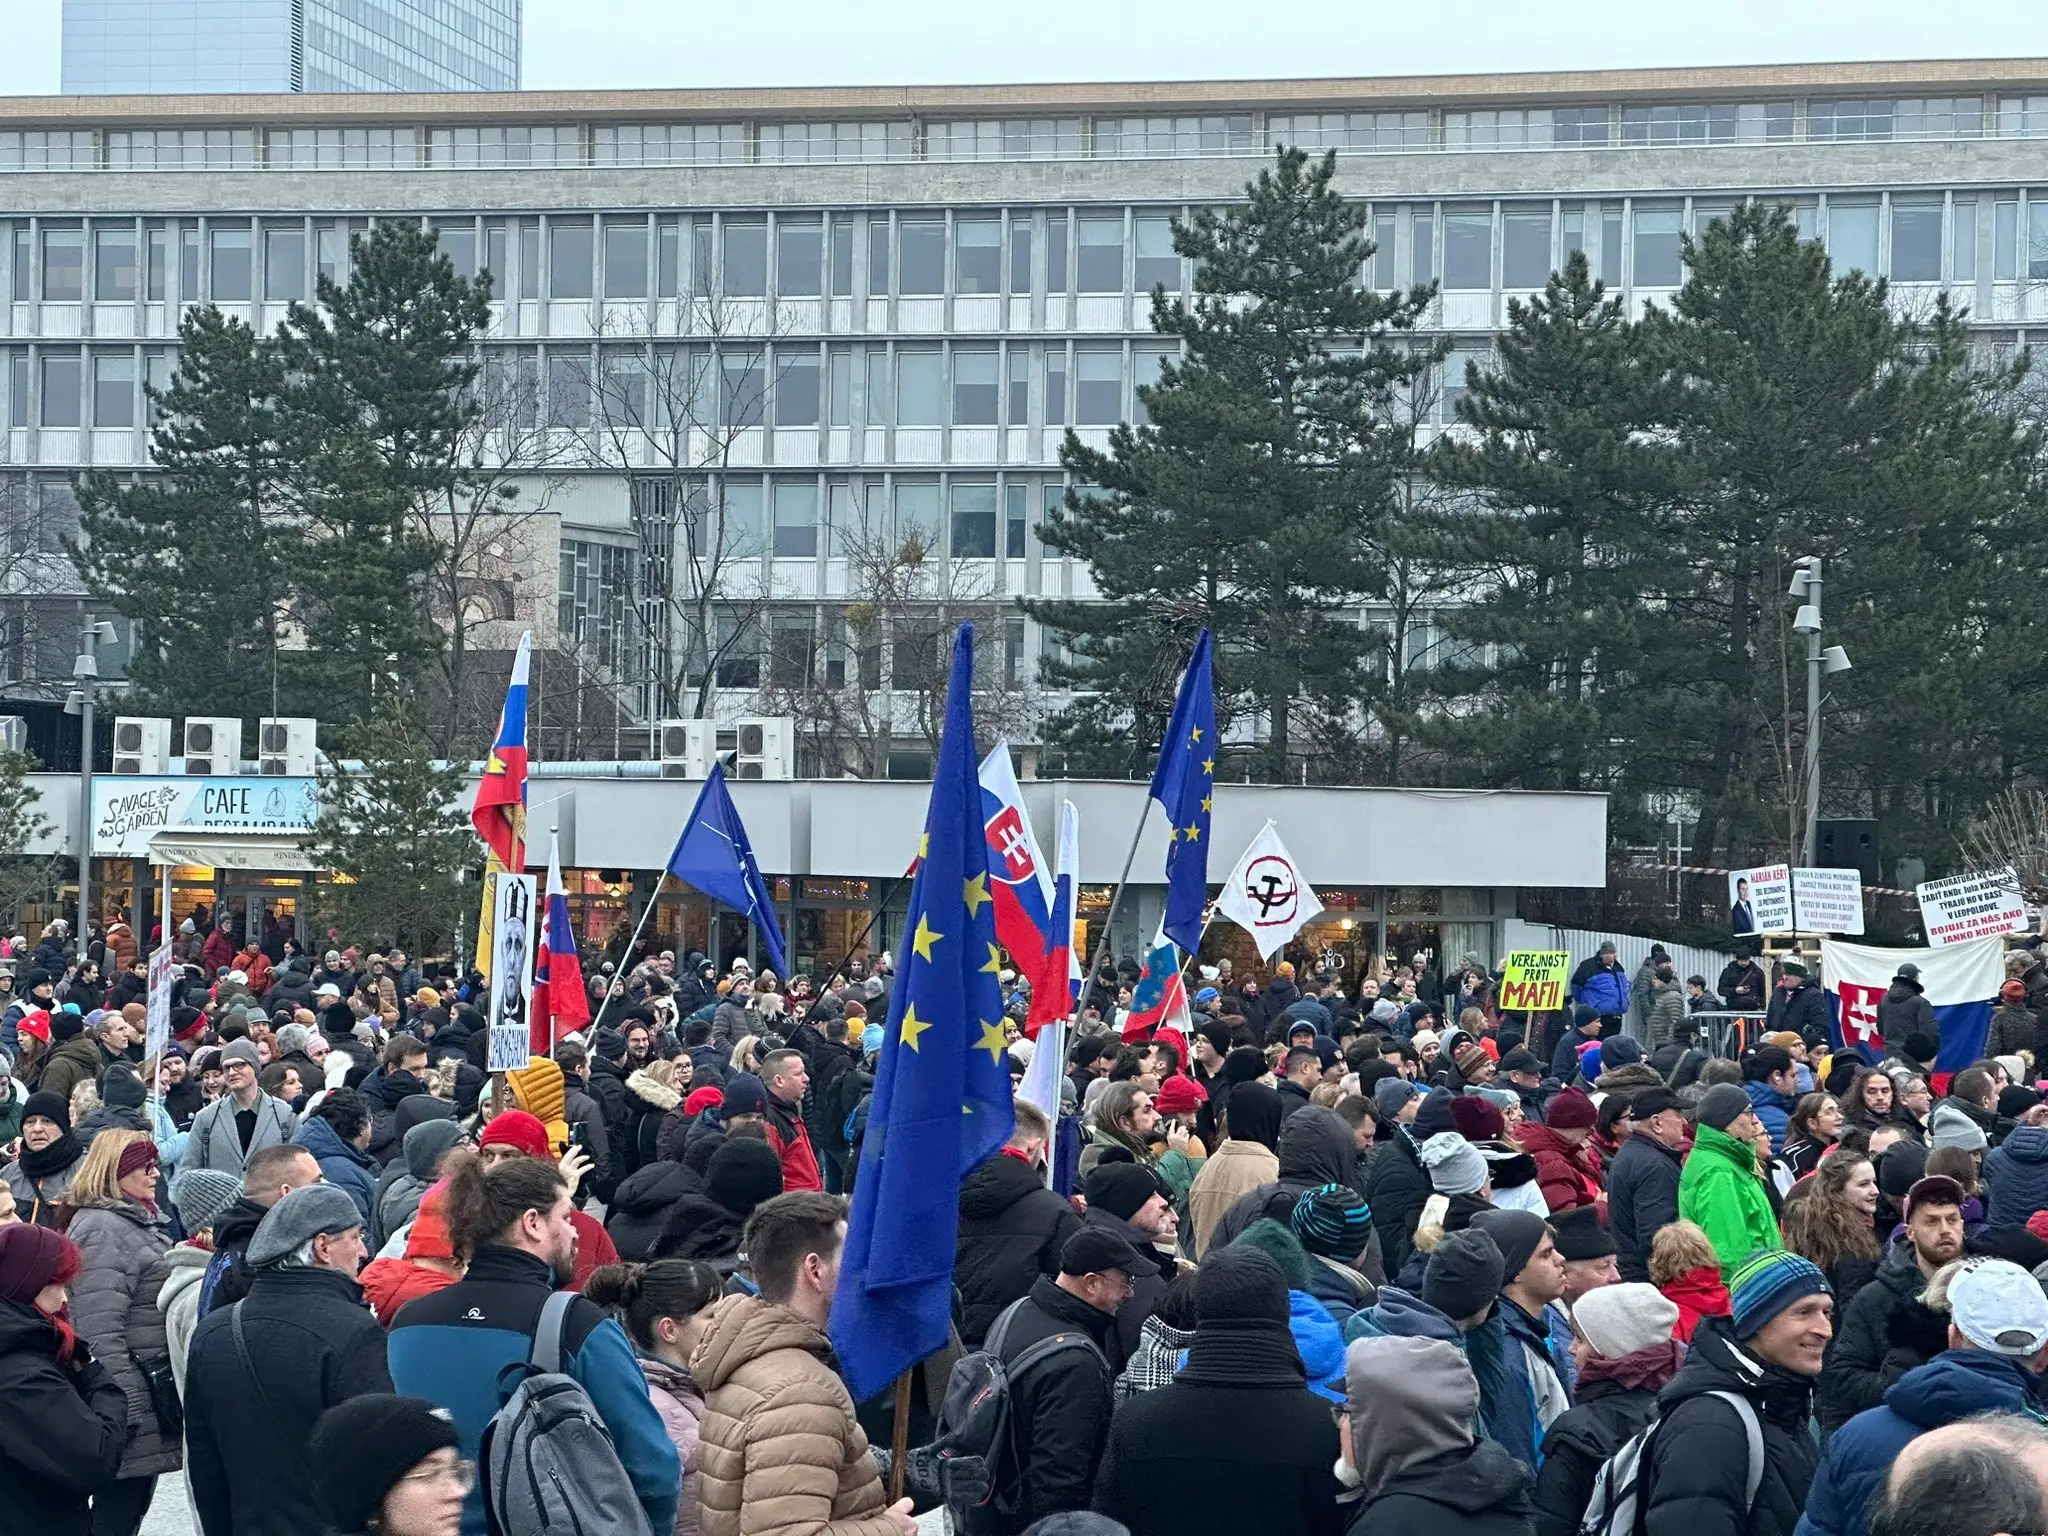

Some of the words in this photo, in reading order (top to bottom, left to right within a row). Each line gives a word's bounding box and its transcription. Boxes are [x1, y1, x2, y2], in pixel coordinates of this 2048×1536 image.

[103, 790, 157, 824] SAVAGE
[204, 788, 251, 814] CAFE
[115, 804, 169, 849] GARDEN
[1978, 894, 1983, 902] V
[1930, 921, 1965, 936] BOJUJE
[1967, 919, 1979, 928] ZA
[1980, 913, 2001, 925] NÁS
[2002, 909, 2023, 920] AKO
[1947, 911, 1954, 920] V
[1943, 930, 1974, 944] JANKO
[1523, 968, 1550, 981] PROTI
[1502, 981, 1560, 1008] MAFII
